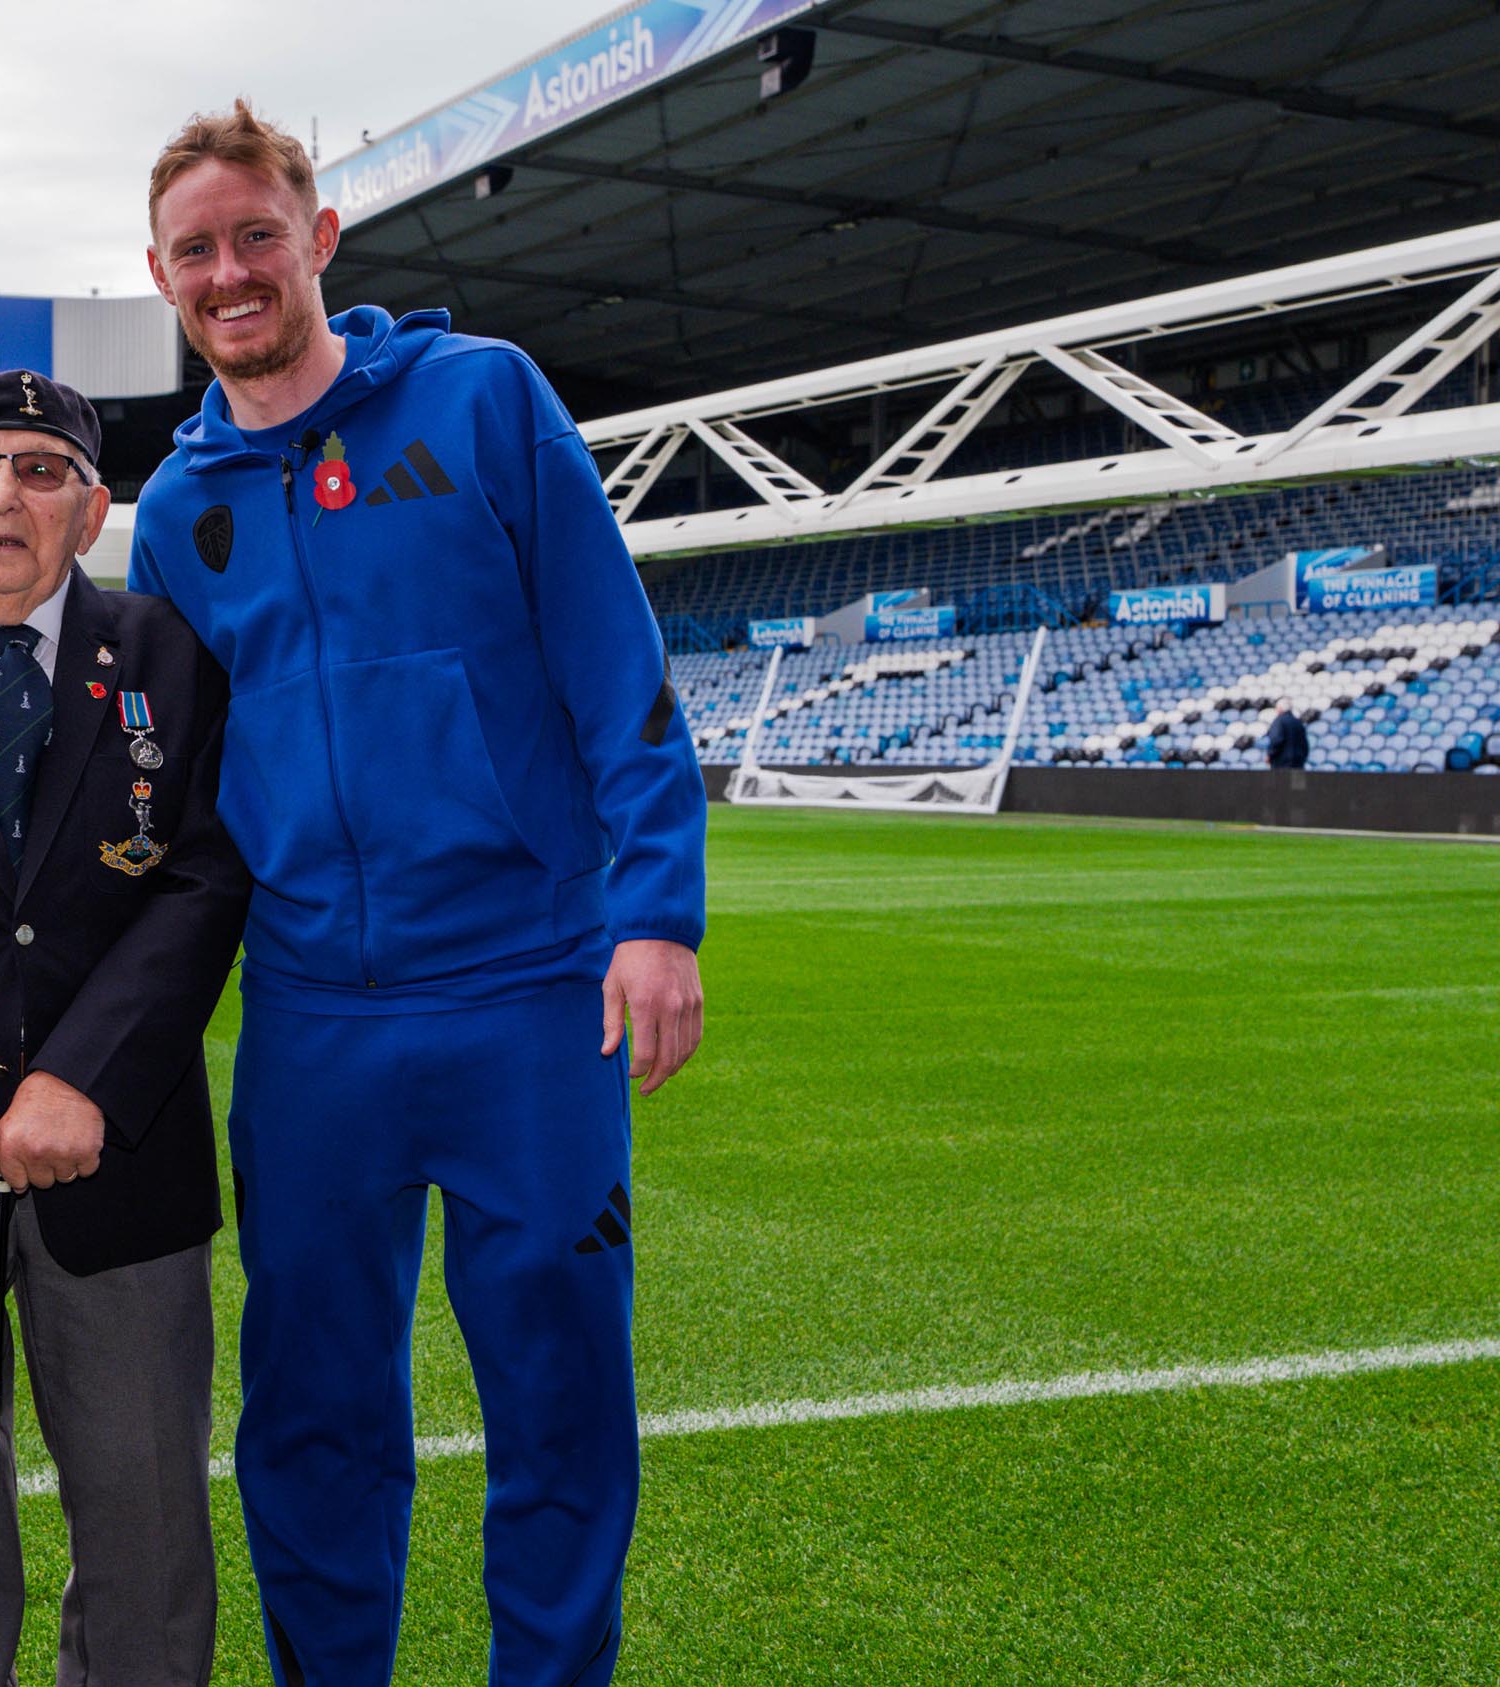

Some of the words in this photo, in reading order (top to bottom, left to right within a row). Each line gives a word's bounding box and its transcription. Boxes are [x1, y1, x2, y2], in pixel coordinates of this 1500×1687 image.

[522, 15, 655, 129] Astonish
[339, 130, 431, 215] Astonish
[1322, 577, 1349, 593] THE
[1351, 571, 1421, 590] PINNACLE
[1322, 593, 1343, 609] OF
[1345, 588, 1420, 608] CLEANING
[1115, 590, 1206, 623] Astonish
